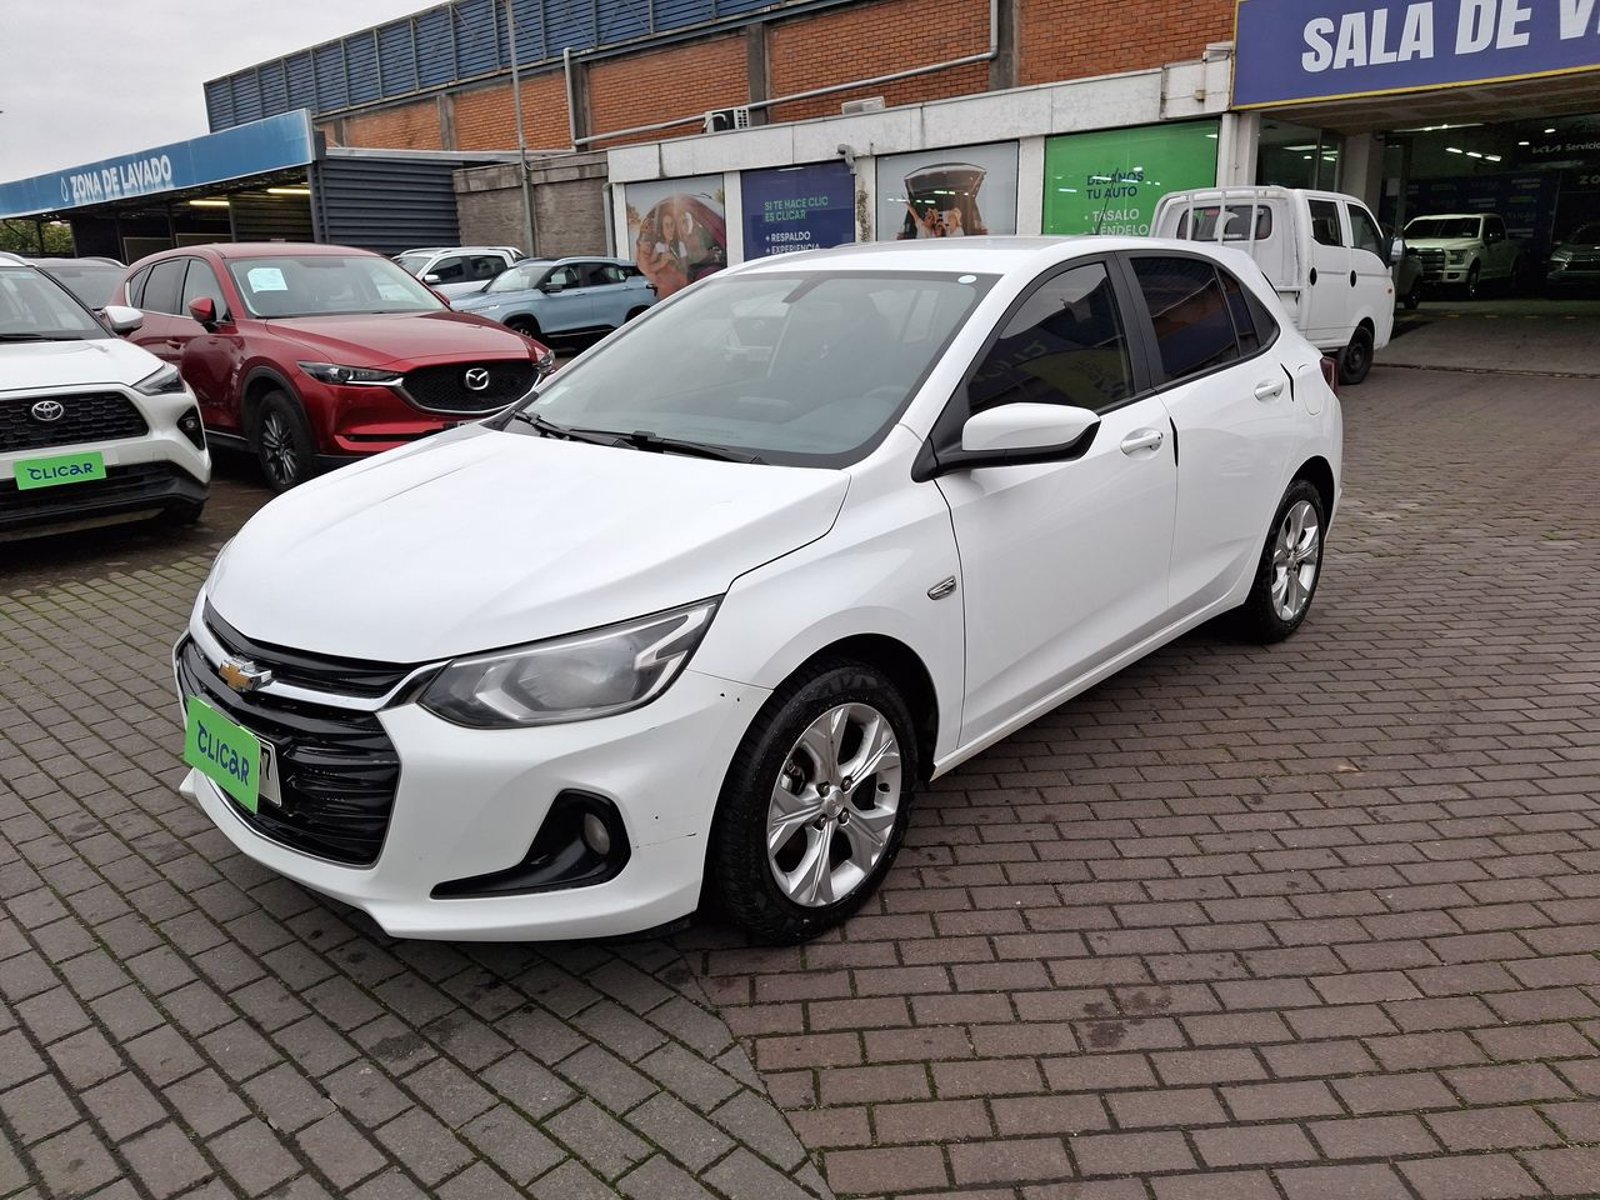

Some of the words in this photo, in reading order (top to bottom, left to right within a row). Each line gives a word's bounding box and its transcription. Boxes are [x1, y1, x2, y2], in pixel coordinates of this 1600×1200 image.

[1301, 1, 1434, 72] SALA
[1455, 0, 1532, 55] DE
[1560, 0, 1600, 40] V
[70, 171, 103, 199] ZONA
[102, 167, 120, 195] DE
[120, 155, 172, 190] LAVADO
[1087, 189, 1101, 200] TU
[1104, 186, 1138, 199] AUTO
[765, 201, 773, 211] SI
[774, 200, 784, 210] TE
[784, 198, 808, 209] HACE
[808, 196, 829, 207] CLIC
[765, 212, 775, 222] ES
[776, 210, 806, 221] CLICAR
[771, 231, 811, 242] RESPALDO
